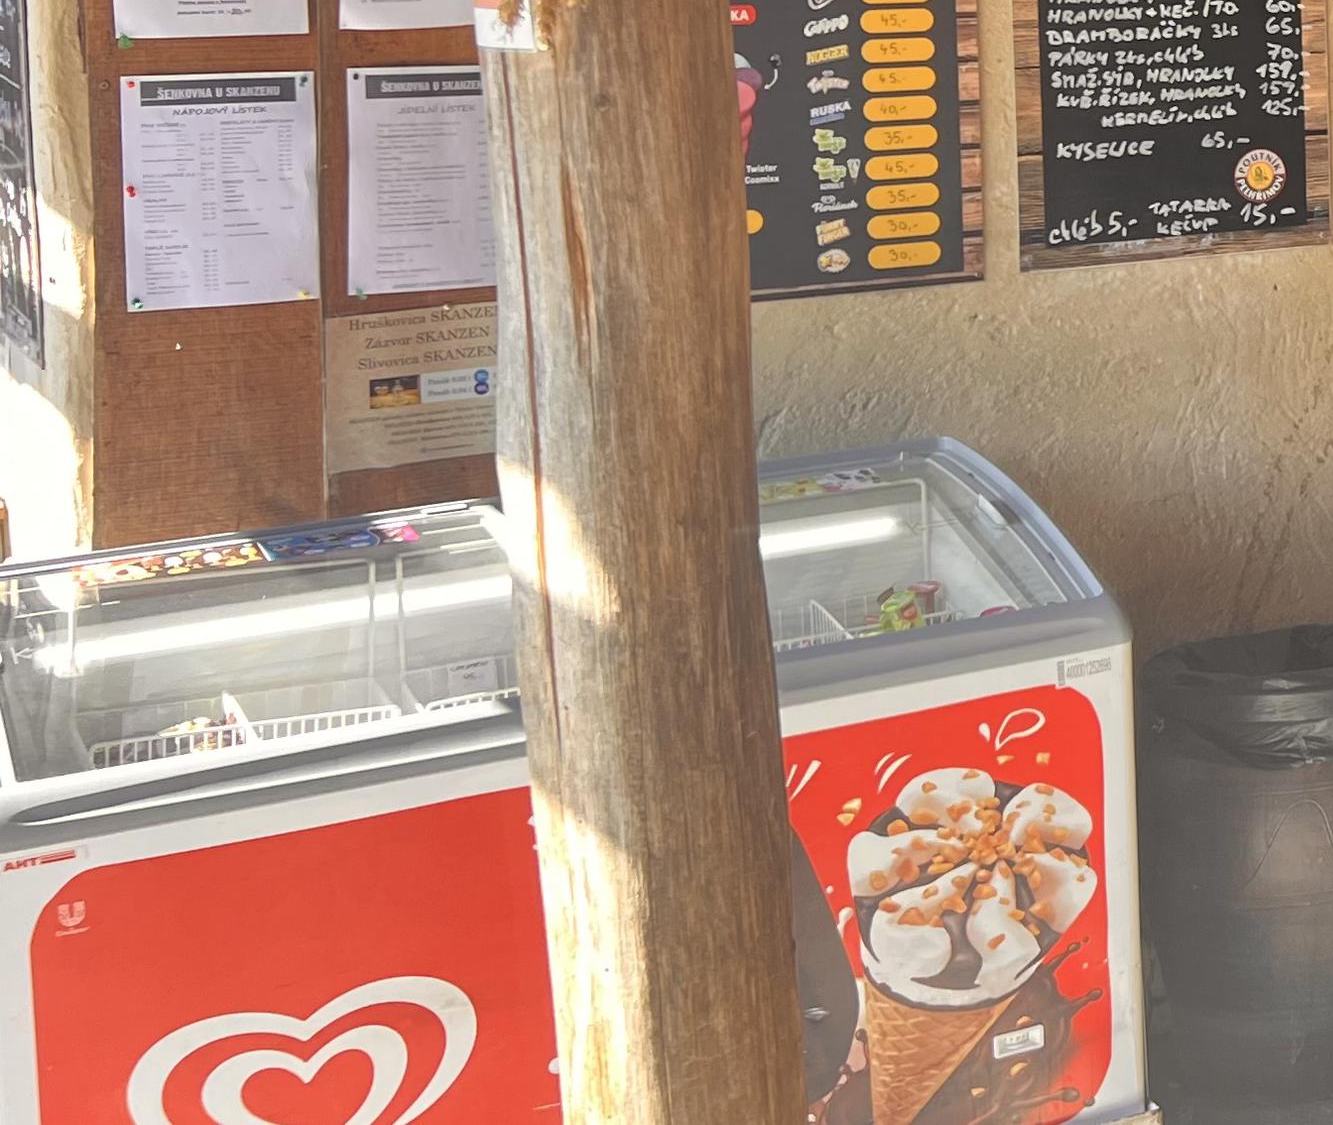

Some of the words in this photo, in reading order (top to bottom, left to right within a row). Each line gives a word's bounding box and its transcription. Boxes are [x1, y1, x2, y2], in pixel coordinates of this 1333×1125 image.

[1047, 7, 1143, 24] HRANOLKY
[1046, 21, 1201, 45] BRAMBORÁČKY
[1048, 47, 1108, 68] PÁRKY
[1146, 66, 1235, 83] HRANOLKY
[157, 87, 212, 100] ŠENKOVNA
[215, 87, 223, 98] U
[226, 86, 280, 97] SKANZENU
[432, 80, 440, 91] U
[172, 105, 228, 116] NÁPOJOVÝ
[232, 105, 267, 114] LÍSTEK
[810, 101, 852, 118] RUSKA
[745, 164, 777, 174] Twister
[1237, 150, 1283, 175] POUTNÍK
[1156, 214, 1218, 236] KEČUP
[365, 336, 412, 349] Zázvor
[416, 325, 490, 344] SKANZEN
[357, 356, 419, 371] Slivovica
